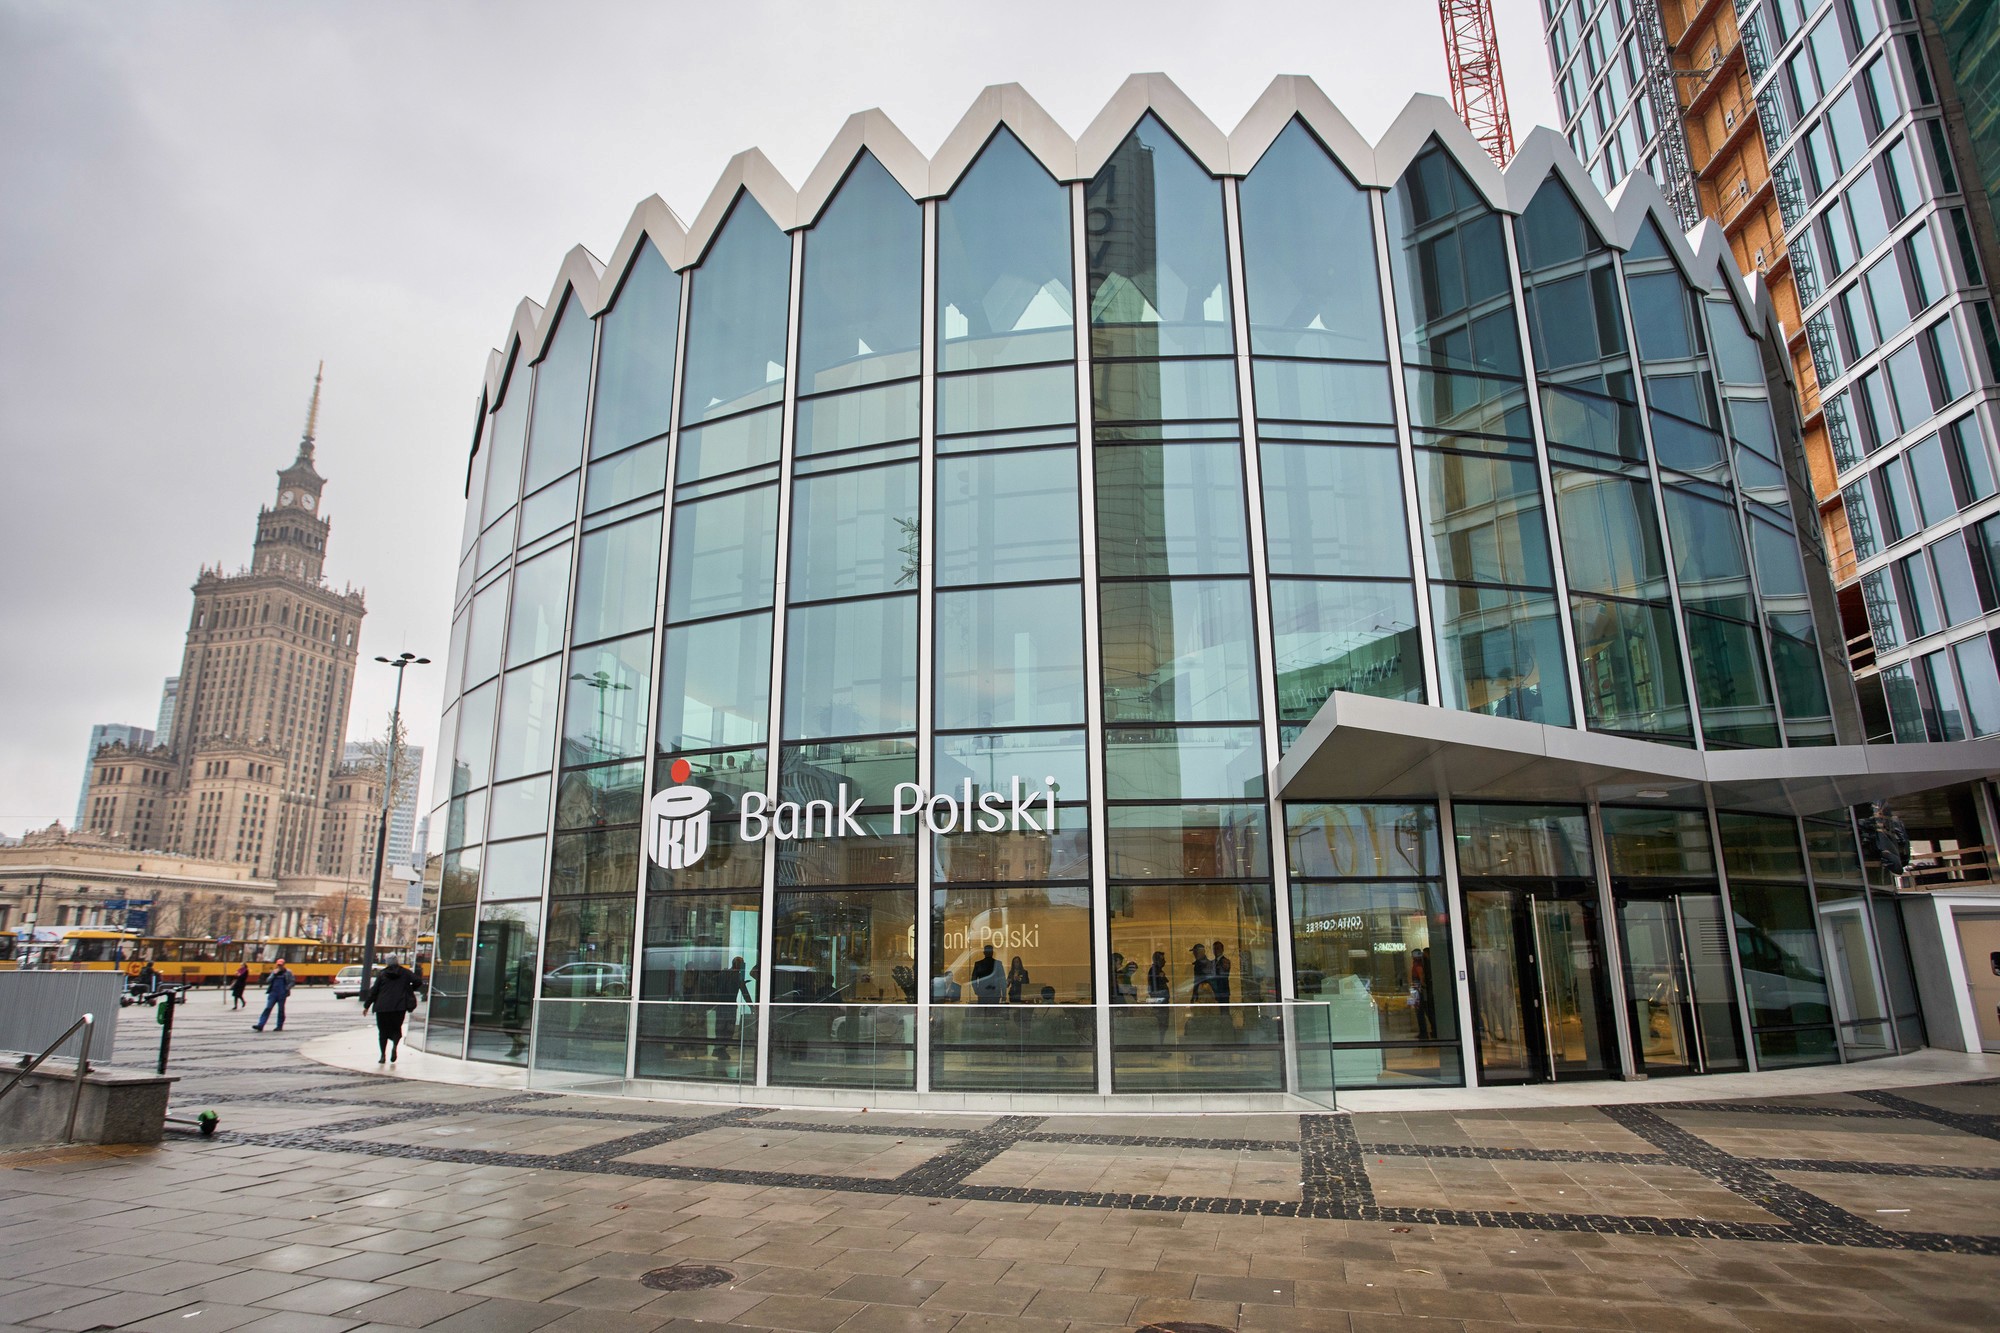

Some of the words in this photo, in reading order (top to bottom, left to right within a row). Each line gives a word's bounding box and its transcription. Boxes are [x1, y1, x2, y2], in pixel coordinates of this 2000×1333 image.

[740, 783, 867, 842] Bank
[893, 775, 1056, 835] Polski
[943, 925, 971, 949] ank
[980, 923, 1039, 949] Polski
